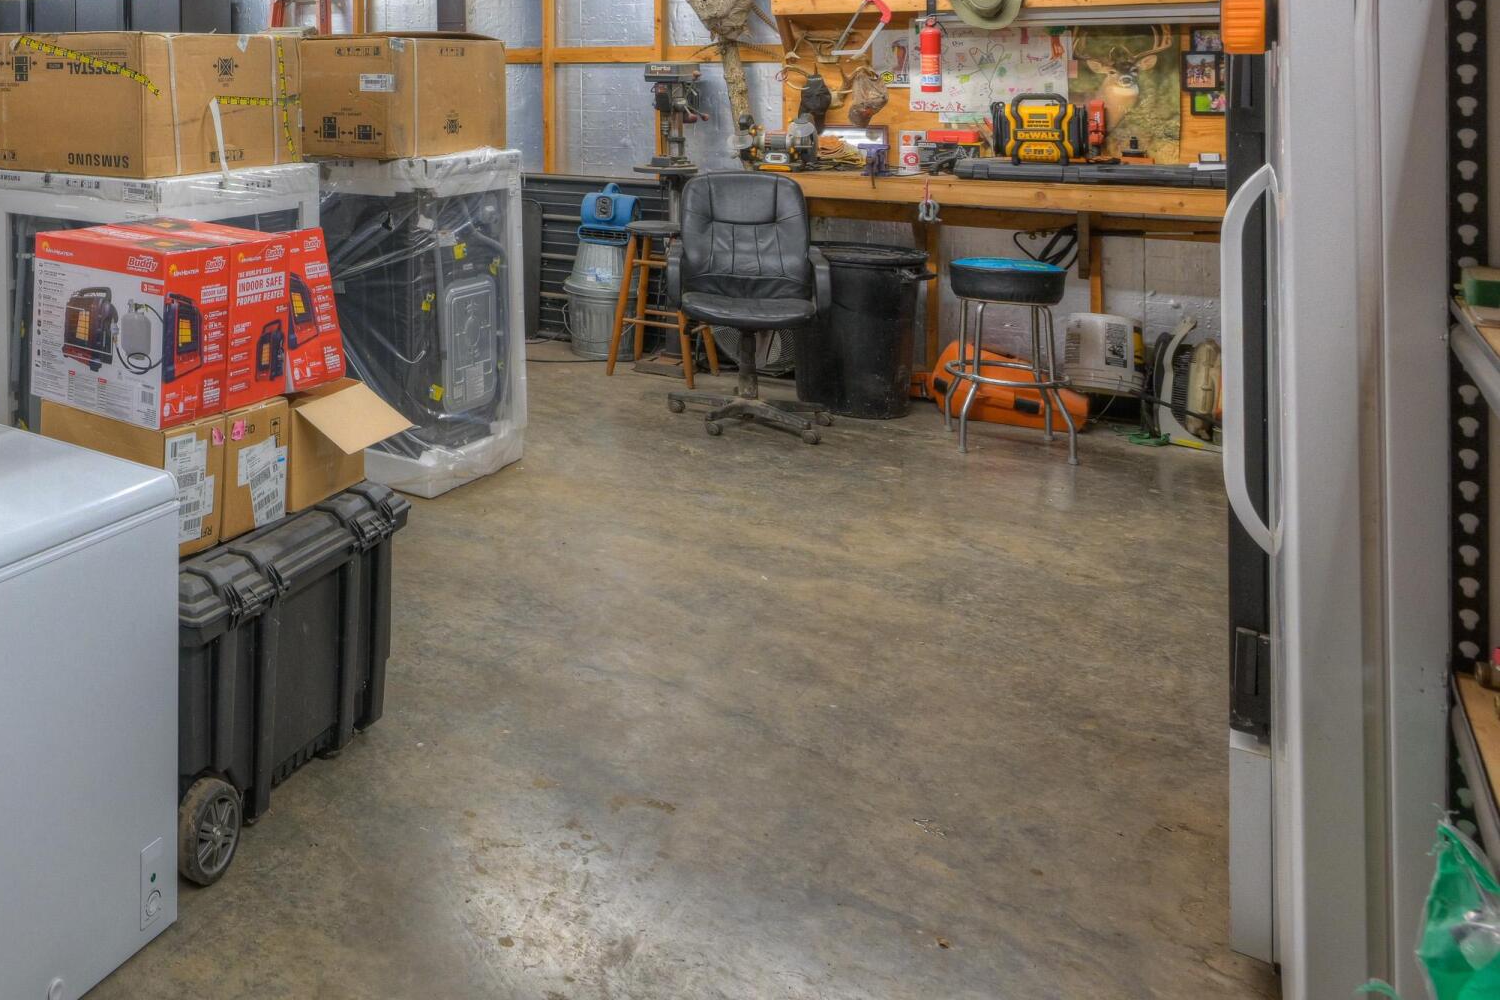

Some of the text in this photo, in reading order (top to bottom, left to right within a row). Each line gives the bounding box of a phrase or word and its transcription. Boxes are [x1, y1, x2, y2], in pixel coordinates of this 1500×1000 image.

[67, 151, 130, 169] SAMSUNG
[266, 247, 286, 259] Buddy
[127, 256, 158, 273] Buddy
[238, 275, 283, 293] INDOOR SAFE
[237, 289, 285, 307] PROPANE HEATER
